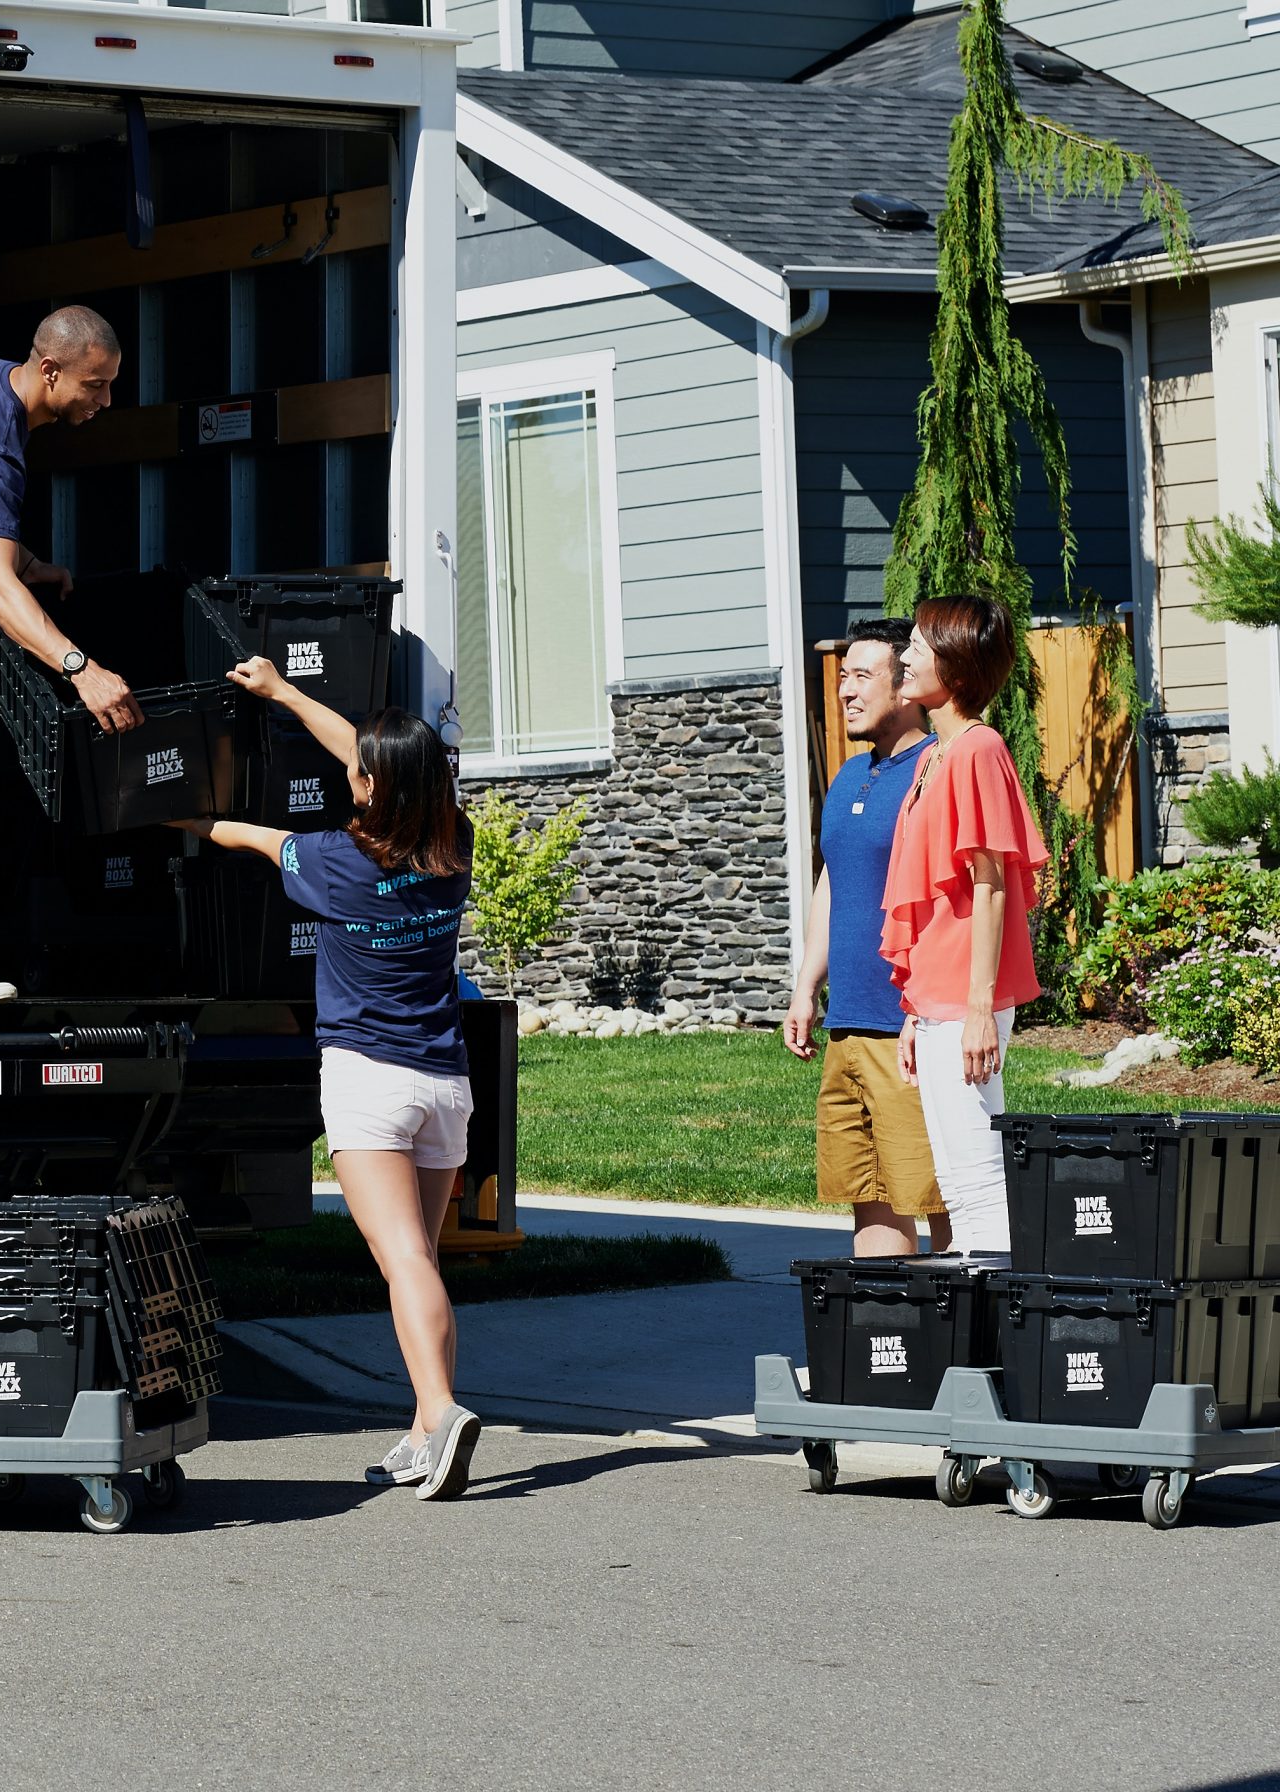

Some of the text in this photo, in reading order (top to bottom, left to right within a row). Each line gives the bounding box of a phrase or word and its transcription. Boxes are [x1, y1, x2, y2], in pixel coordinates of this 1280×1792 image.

[287, 641, 319, 656] HIVE
[286, 655, 324, 669] BOXX
[145, 747, 178, 766] HIVE
[146, 759, 184, 778] BOXX
[289, 778, 320, 791] HIVE
[289, 790, 324, 806] BOXX
[106, 856, 131, 869] HIVE
[106, 868, 134, 881] BOXX
[376, 917, 405, 931] rent
[371, 918, 459, 948] moving boxes
[48, 1065, 97, 1082] WALTCO
[1074, 1196, 1107, 1212] HIVE
[1075, 1211, 1112, 1227] BOXX
[870, 1335, 902, 1351] HIVE
[870, 1350, 907, 1366] BOXX
[1066, 1352, 1099, 1368] HIVE
[1066, 1367, 1104, 1383] BOXX
